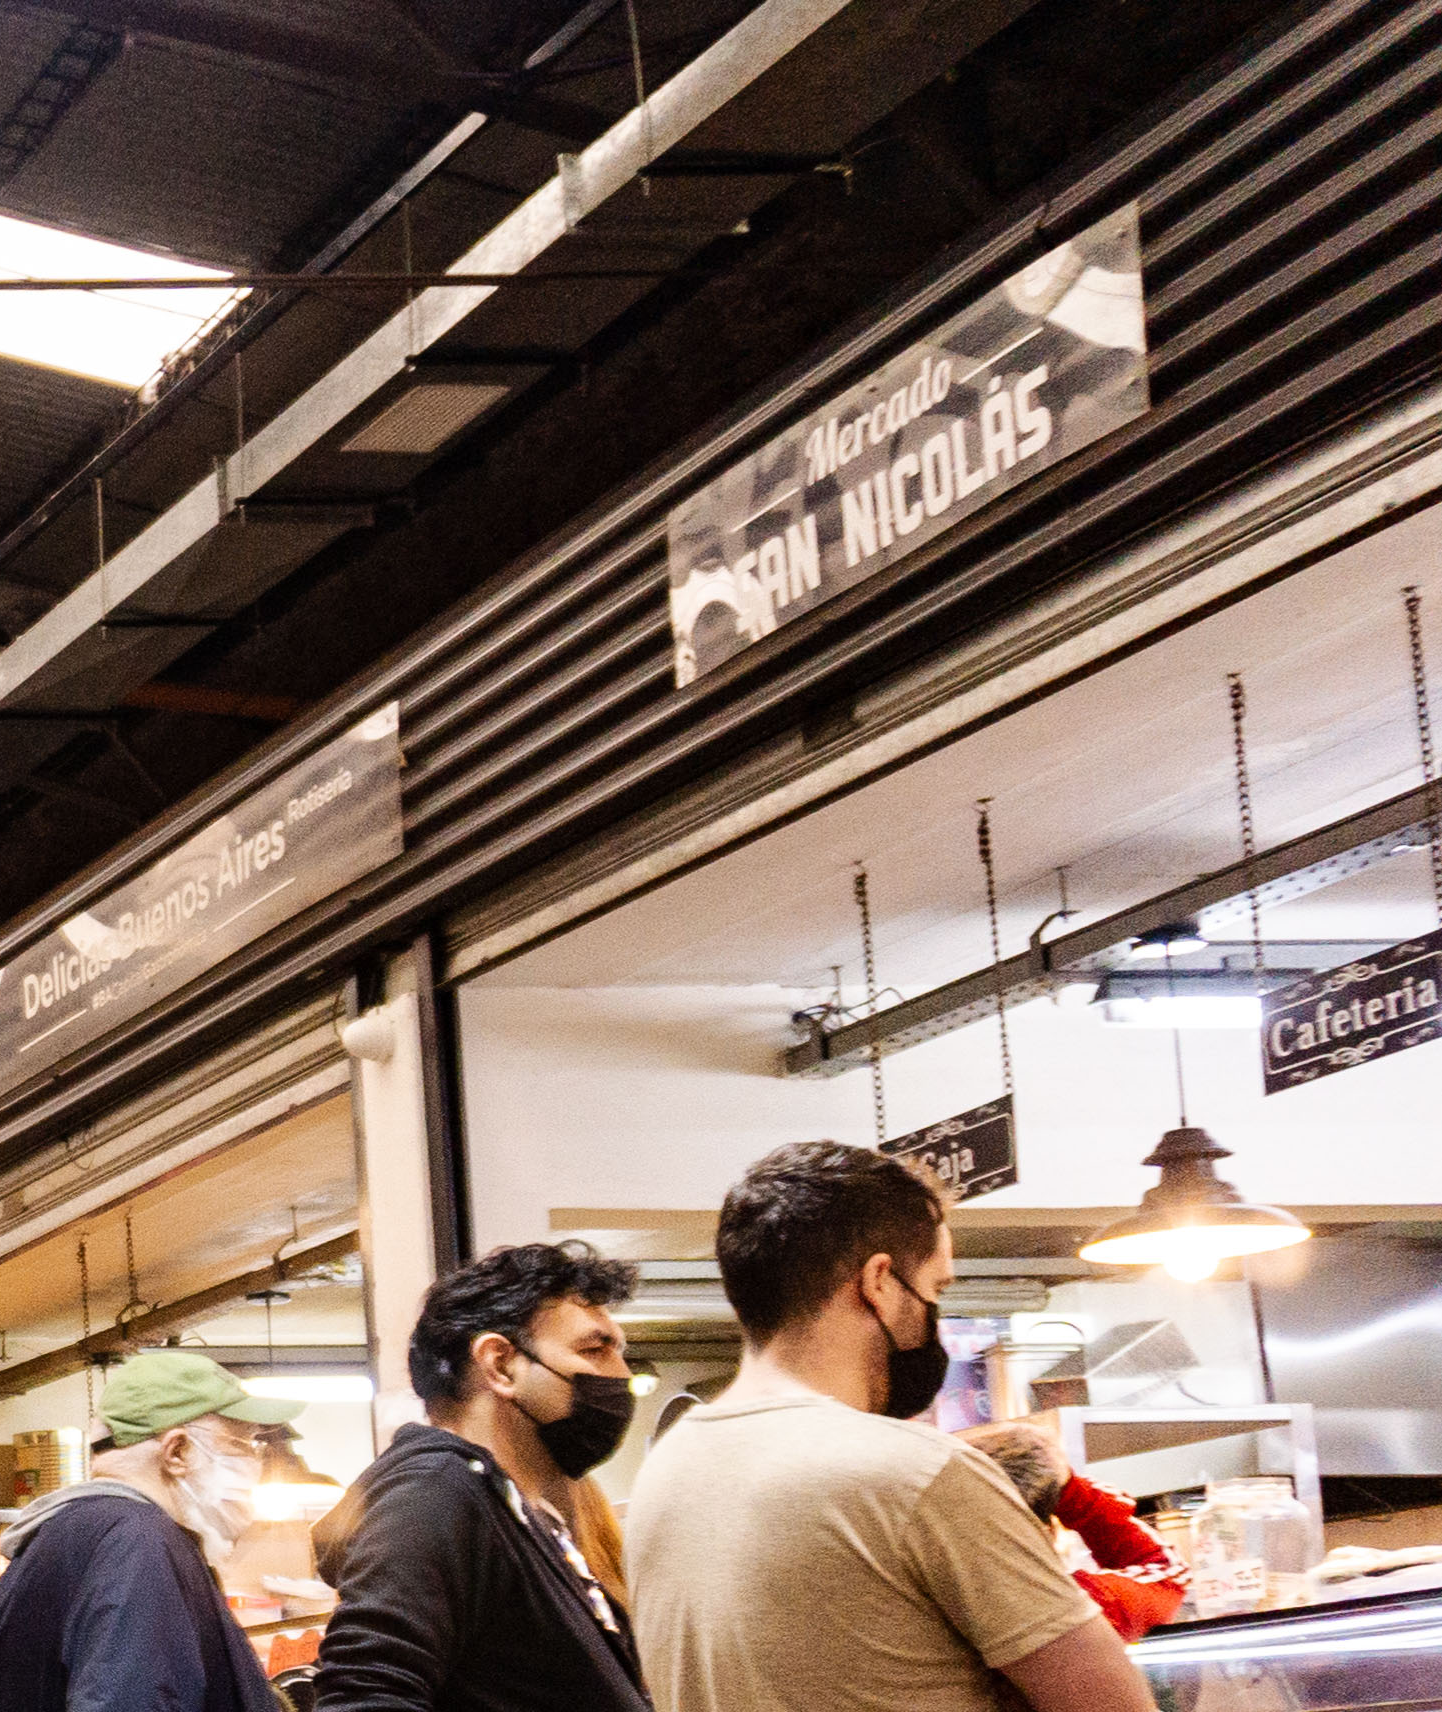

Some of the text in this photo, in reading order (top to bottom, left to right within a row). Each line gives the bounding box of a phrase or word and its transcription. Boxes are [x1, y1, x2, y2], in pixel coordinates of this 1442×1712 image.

[804, 358, 953, 486] Mercado
[736, 365, 1053, 626] SAN NICOLÁS
[117, 871, 210, 952] Buenos
[217, 820, 285, 898] Aires
